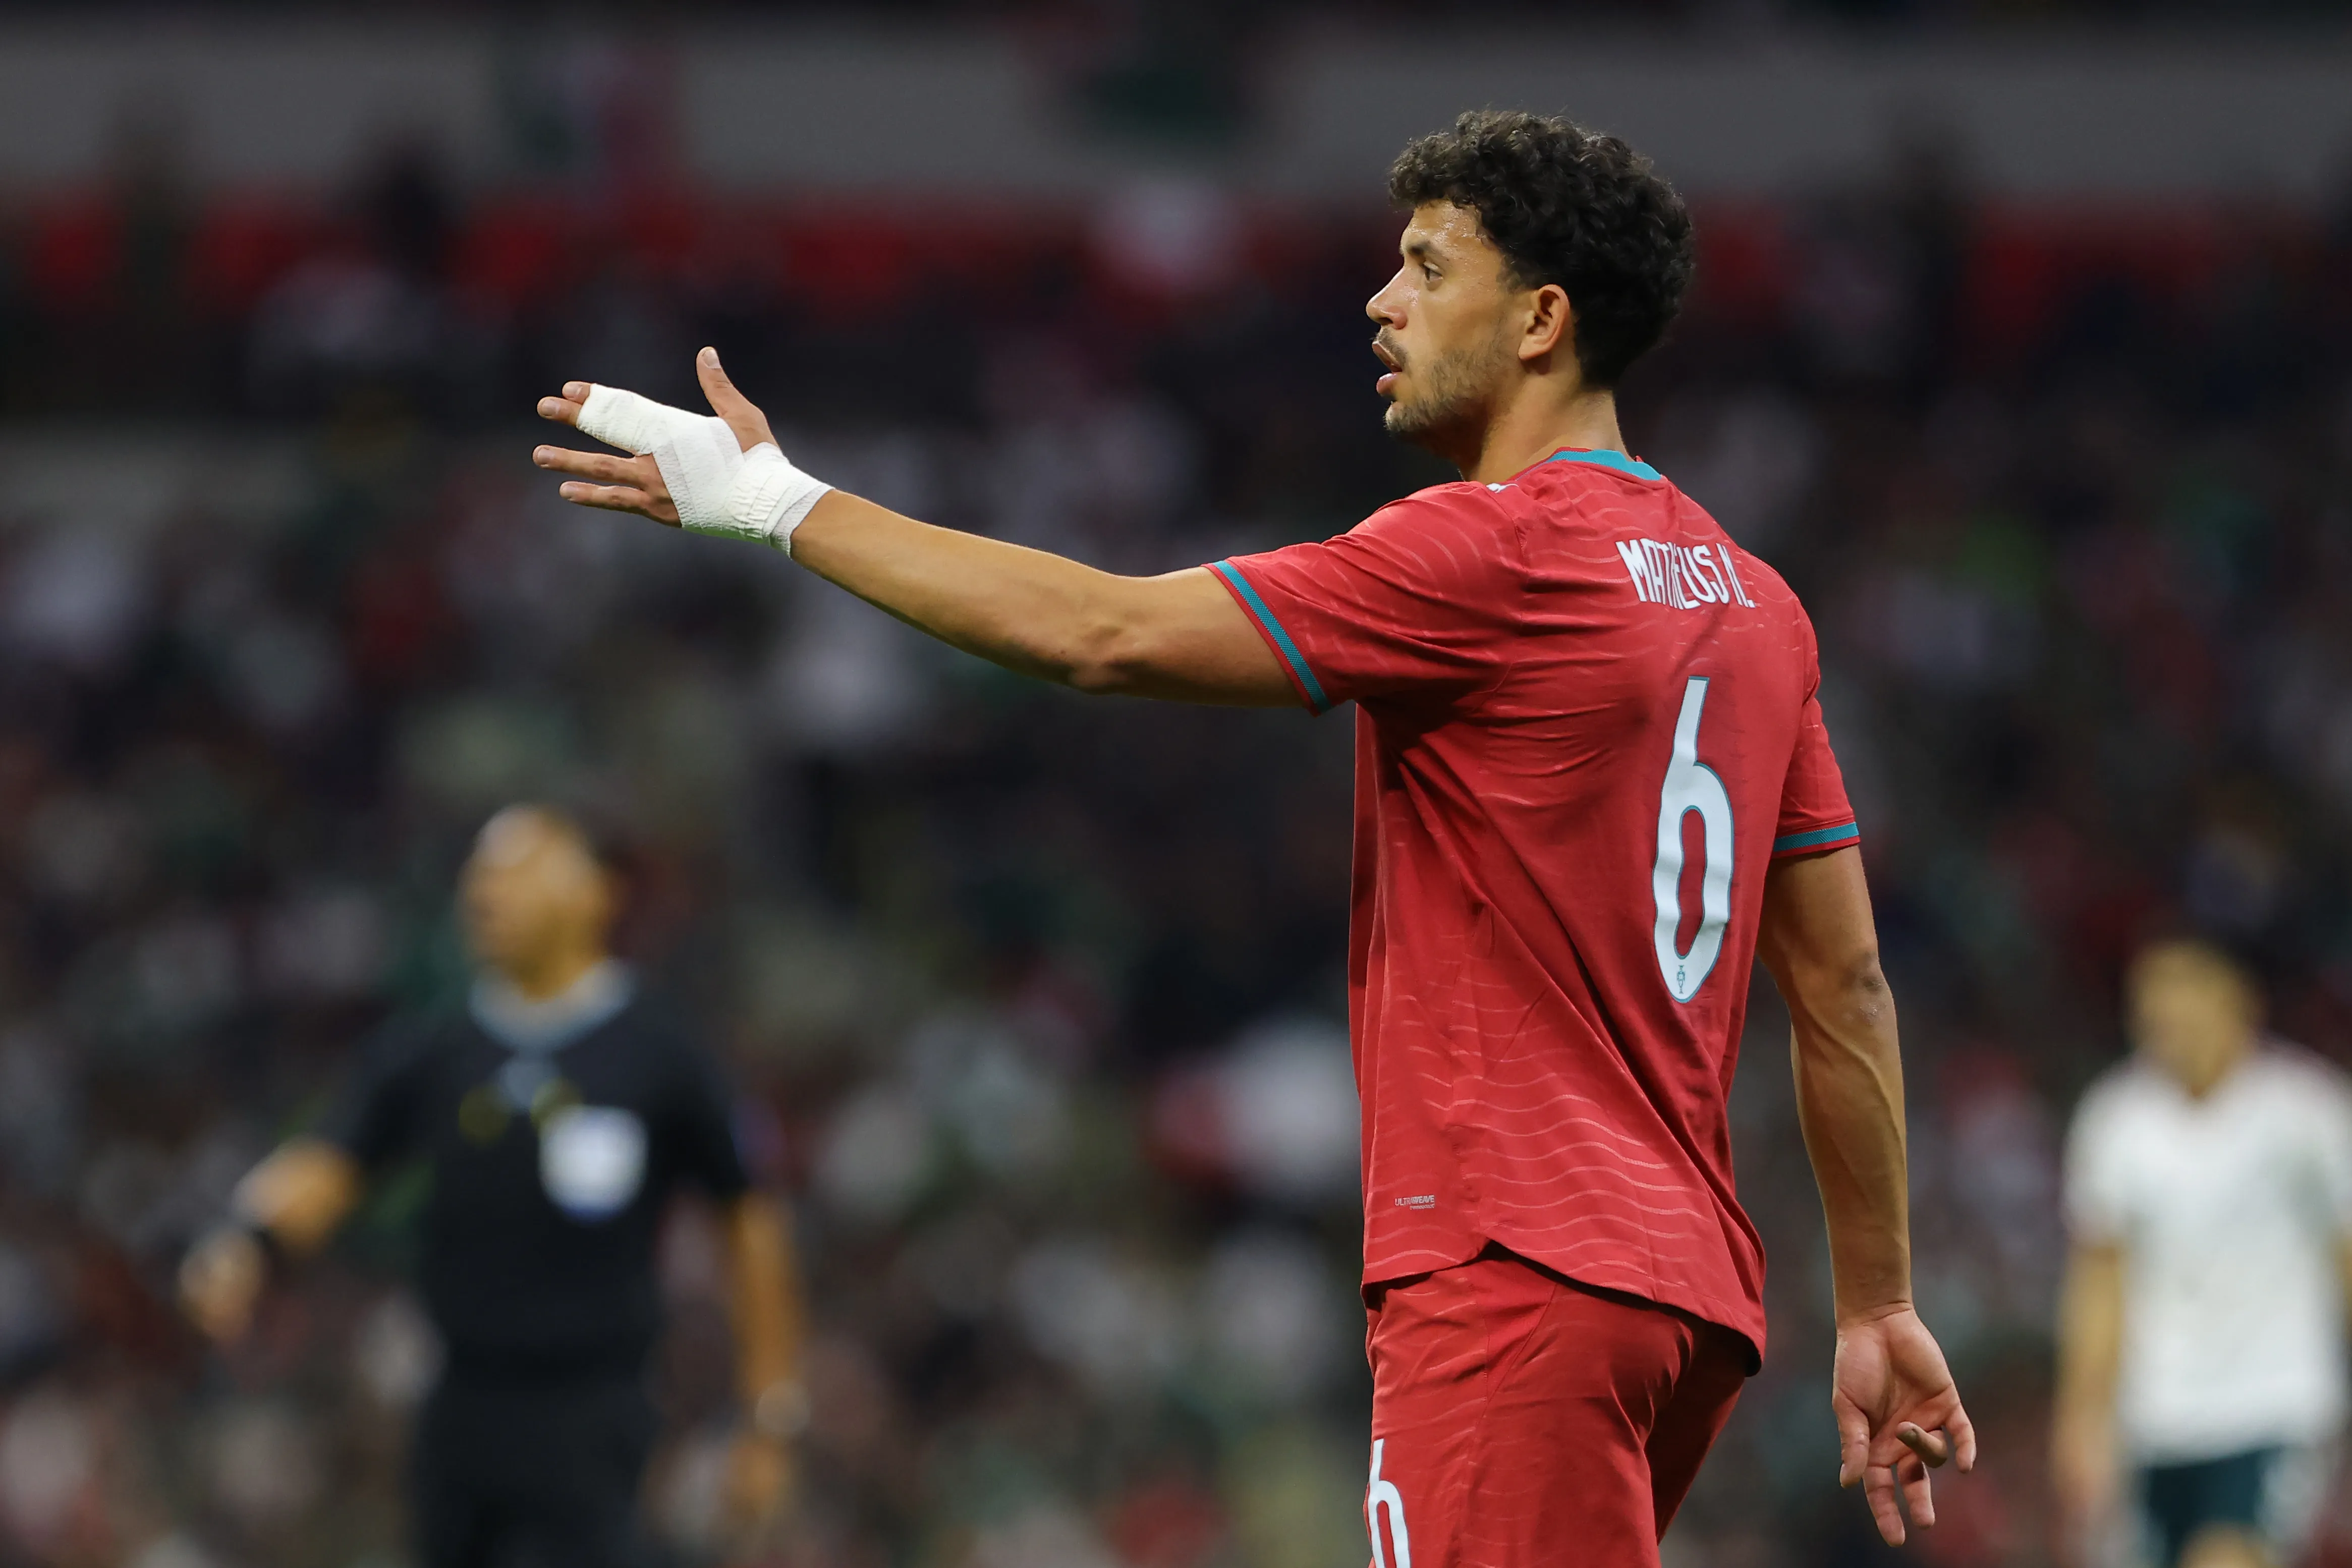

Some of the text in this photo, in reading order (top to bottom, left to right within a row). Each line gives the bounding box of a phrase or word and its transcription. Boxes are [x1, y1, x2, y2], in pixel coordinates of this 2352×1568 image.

[1615, 538, 1729, 609] MATHEUS
[1652, 676, 1734, 1003] 6
[1395, 1195, 1434, 1206] ULTRAWEAVE
[1368, 1438, 1411, 1568] 6
